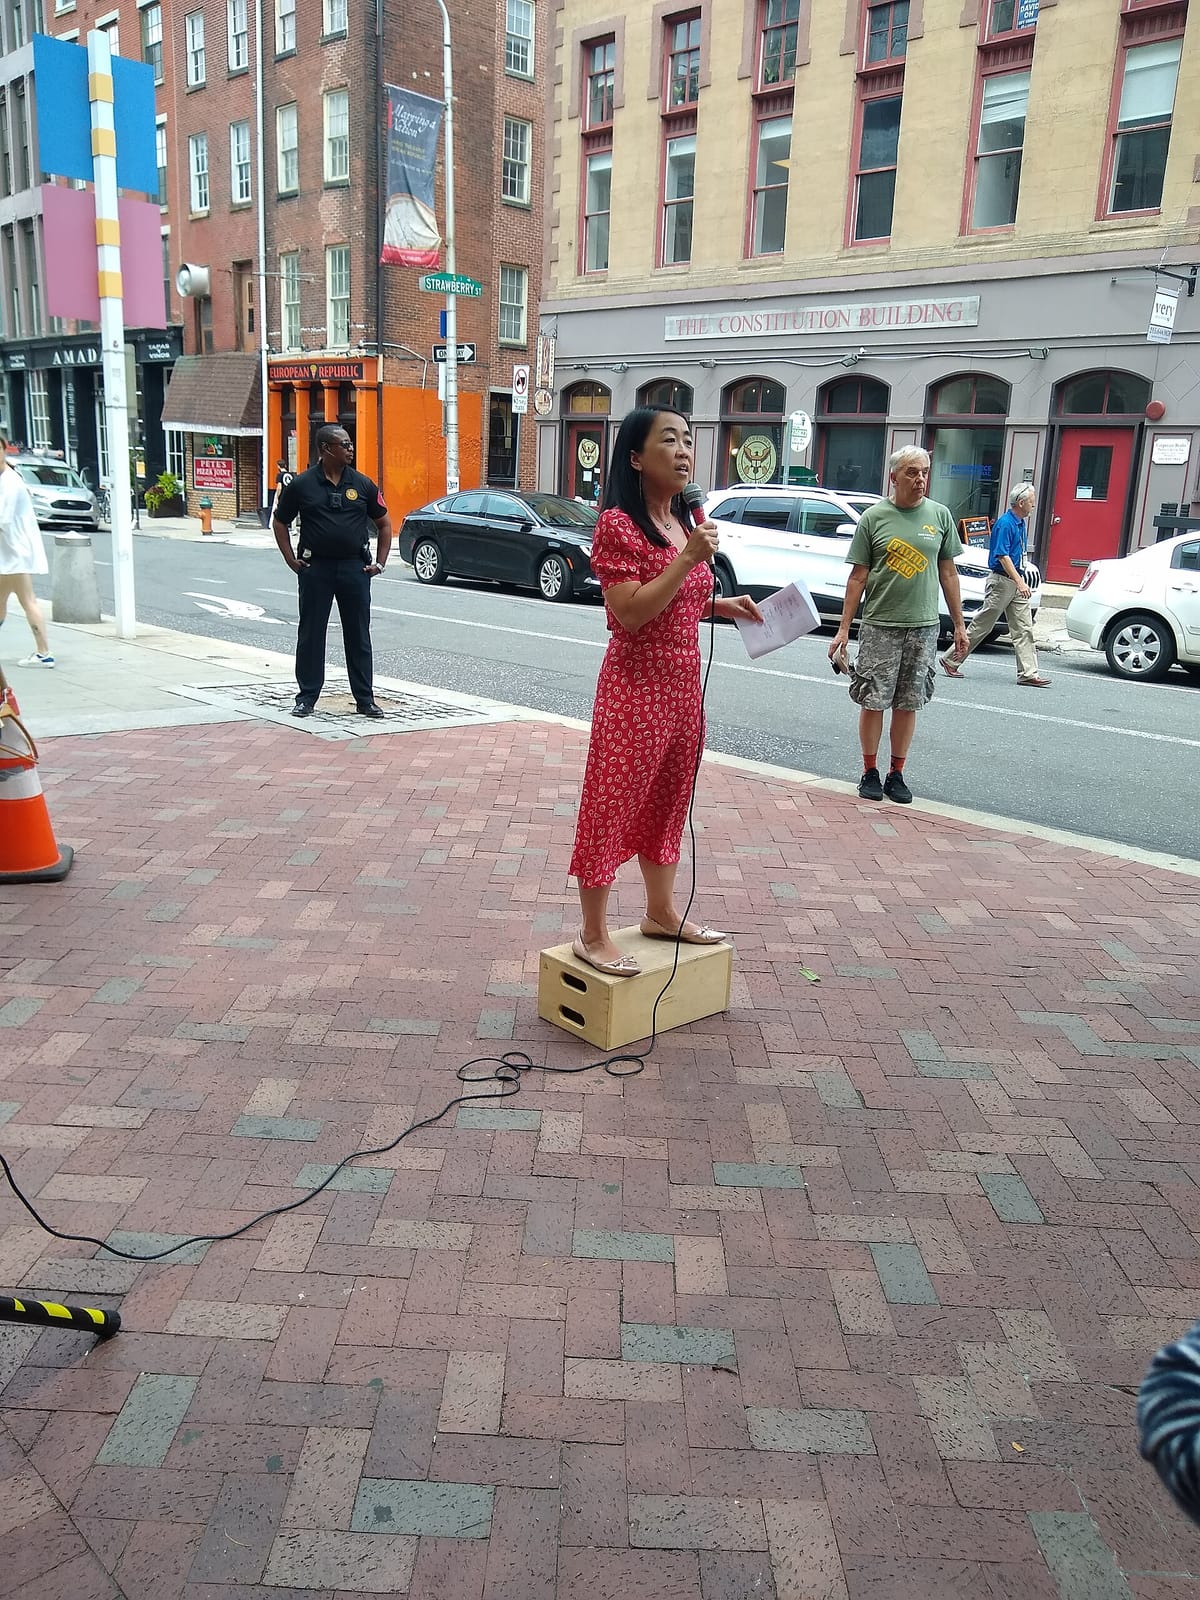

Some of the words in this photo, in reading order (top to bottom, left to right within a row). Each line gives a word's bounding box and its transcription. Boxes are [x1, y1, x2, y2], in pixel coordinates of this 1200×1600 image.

[1021, 3, 1039, 12] DAVID
[425, 278, 474, 295] STRAWBERRY
[475, 287, 482, 296] ST
[676, 319, 708, 336] THE
[719, 310, 850, 334] CONSTITUTION
[858, 302, 963, 327] BUILDING
[269, 367, 309, 379] EUROPEAN
[318, 365, 359, 377] REPUBLIC
[196, 468, 213, 476] PIZZA
[213, 469, 231, 477] JOINT
